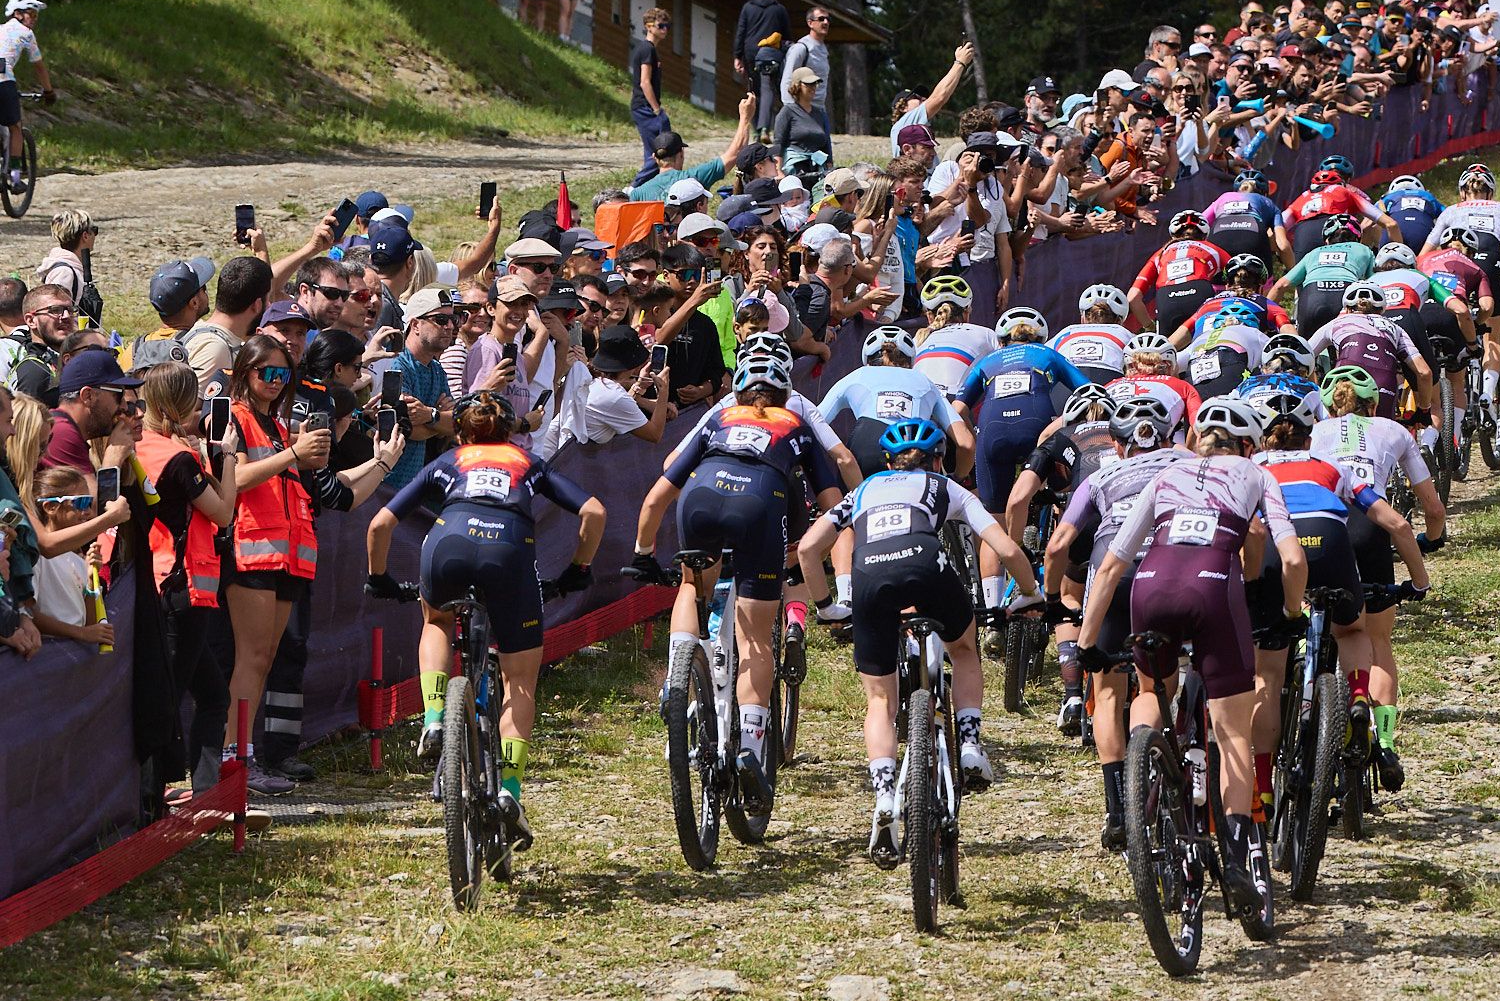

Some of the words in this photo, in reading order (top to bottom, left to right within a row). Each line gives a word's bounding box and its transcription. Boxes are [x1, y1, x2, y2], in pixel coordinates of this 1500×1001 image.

[1172, 263, 1189, 274] 24
[1317, 281, 1345, 289] BIXS
[1075, 346, 1097, 356] 22
[1002, 381, 1023, 391] 59
[883, 400, 907, 412] 54
[735, 431, 763, 443] 57
[1357, 423, 1367, 452] SRAM
[475, 474, 503, 488] 58
[716, 481, 746, 492] RALI
[874, 504, 905, 512] WHOOP
[874, 513, 903, 528] 48
[1179, 520, 1208, 532] 50
[468, 528, 500, 539] RALI
[864, 547, 914, 564] SCHWALBE
[1198, 570, 1228, 580] Santini
